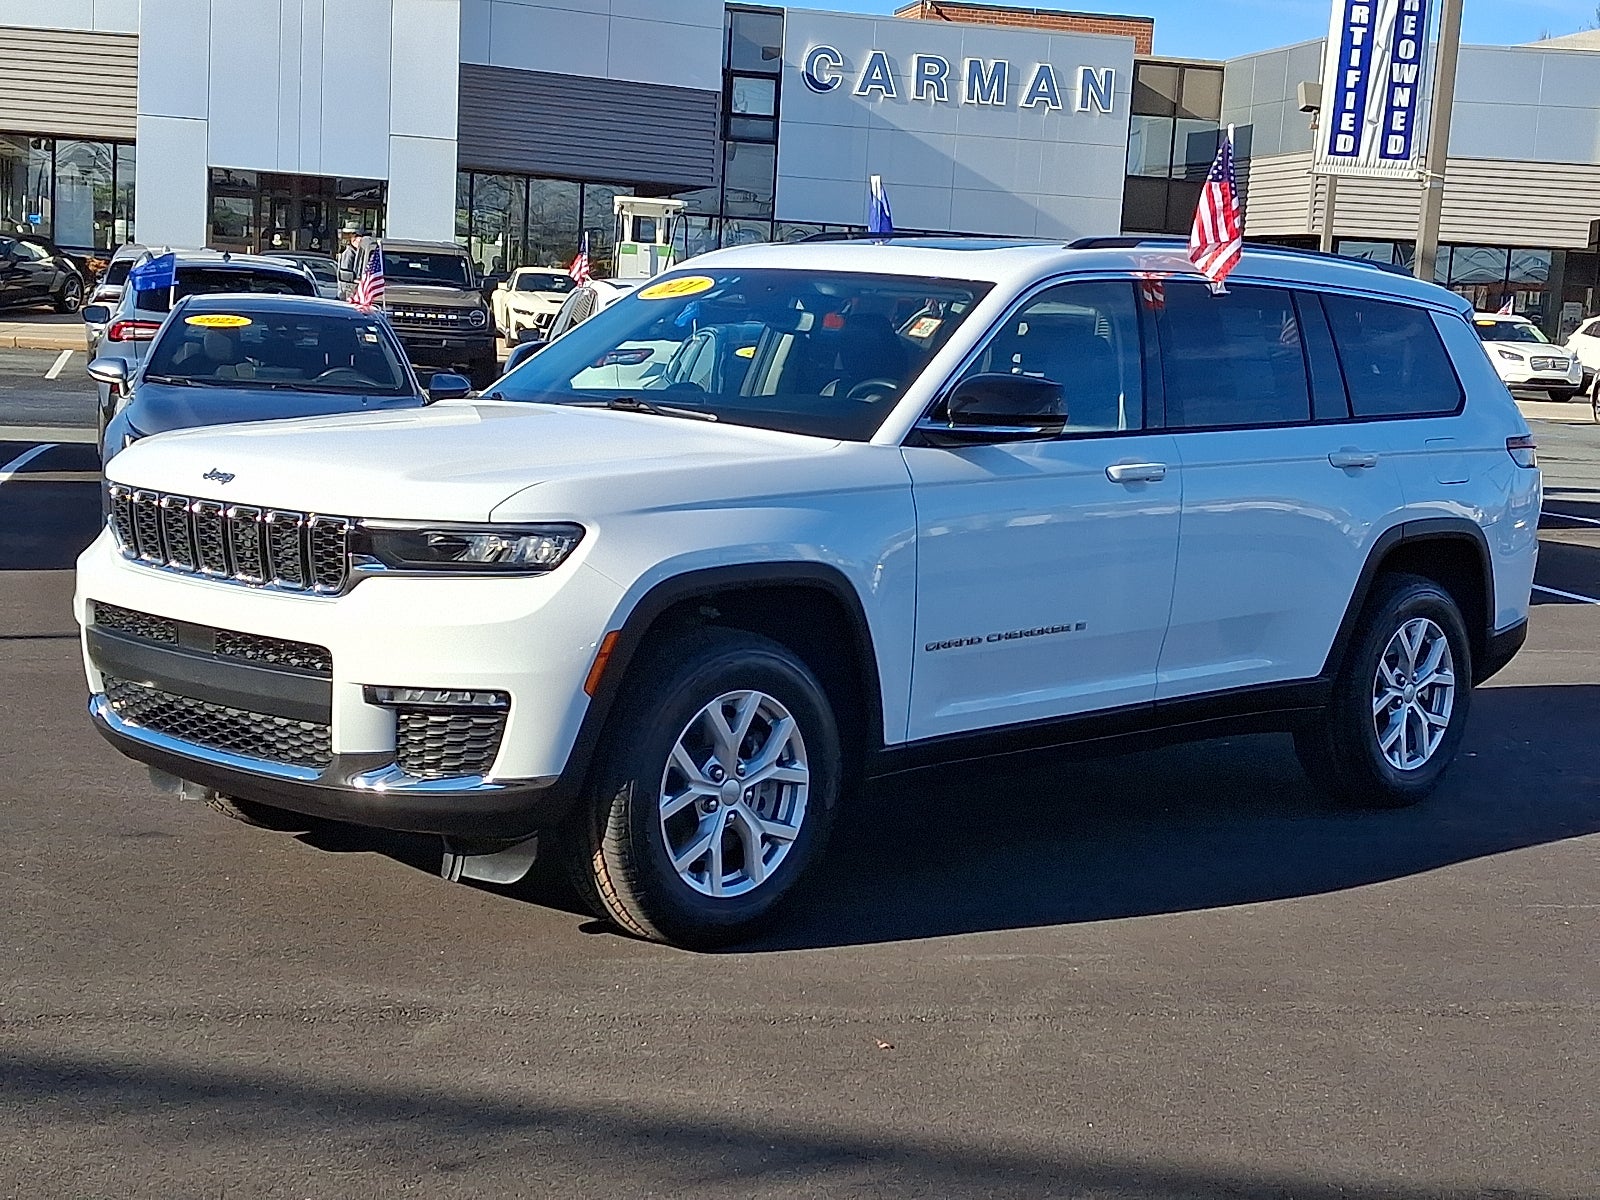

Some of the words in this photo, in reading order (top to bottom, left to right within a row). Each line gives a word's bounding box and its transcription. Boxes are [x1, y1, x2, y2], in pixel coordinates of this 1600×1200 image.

[801, 44, 1116, 113] CARMAN
[1335, 0, 1371, 153] RTIFIED
[202, 467, 236, 485] Jeep
[924, 636, 983, 652] GRAND
[986, 624, 1072, 644] CHEROKEE
